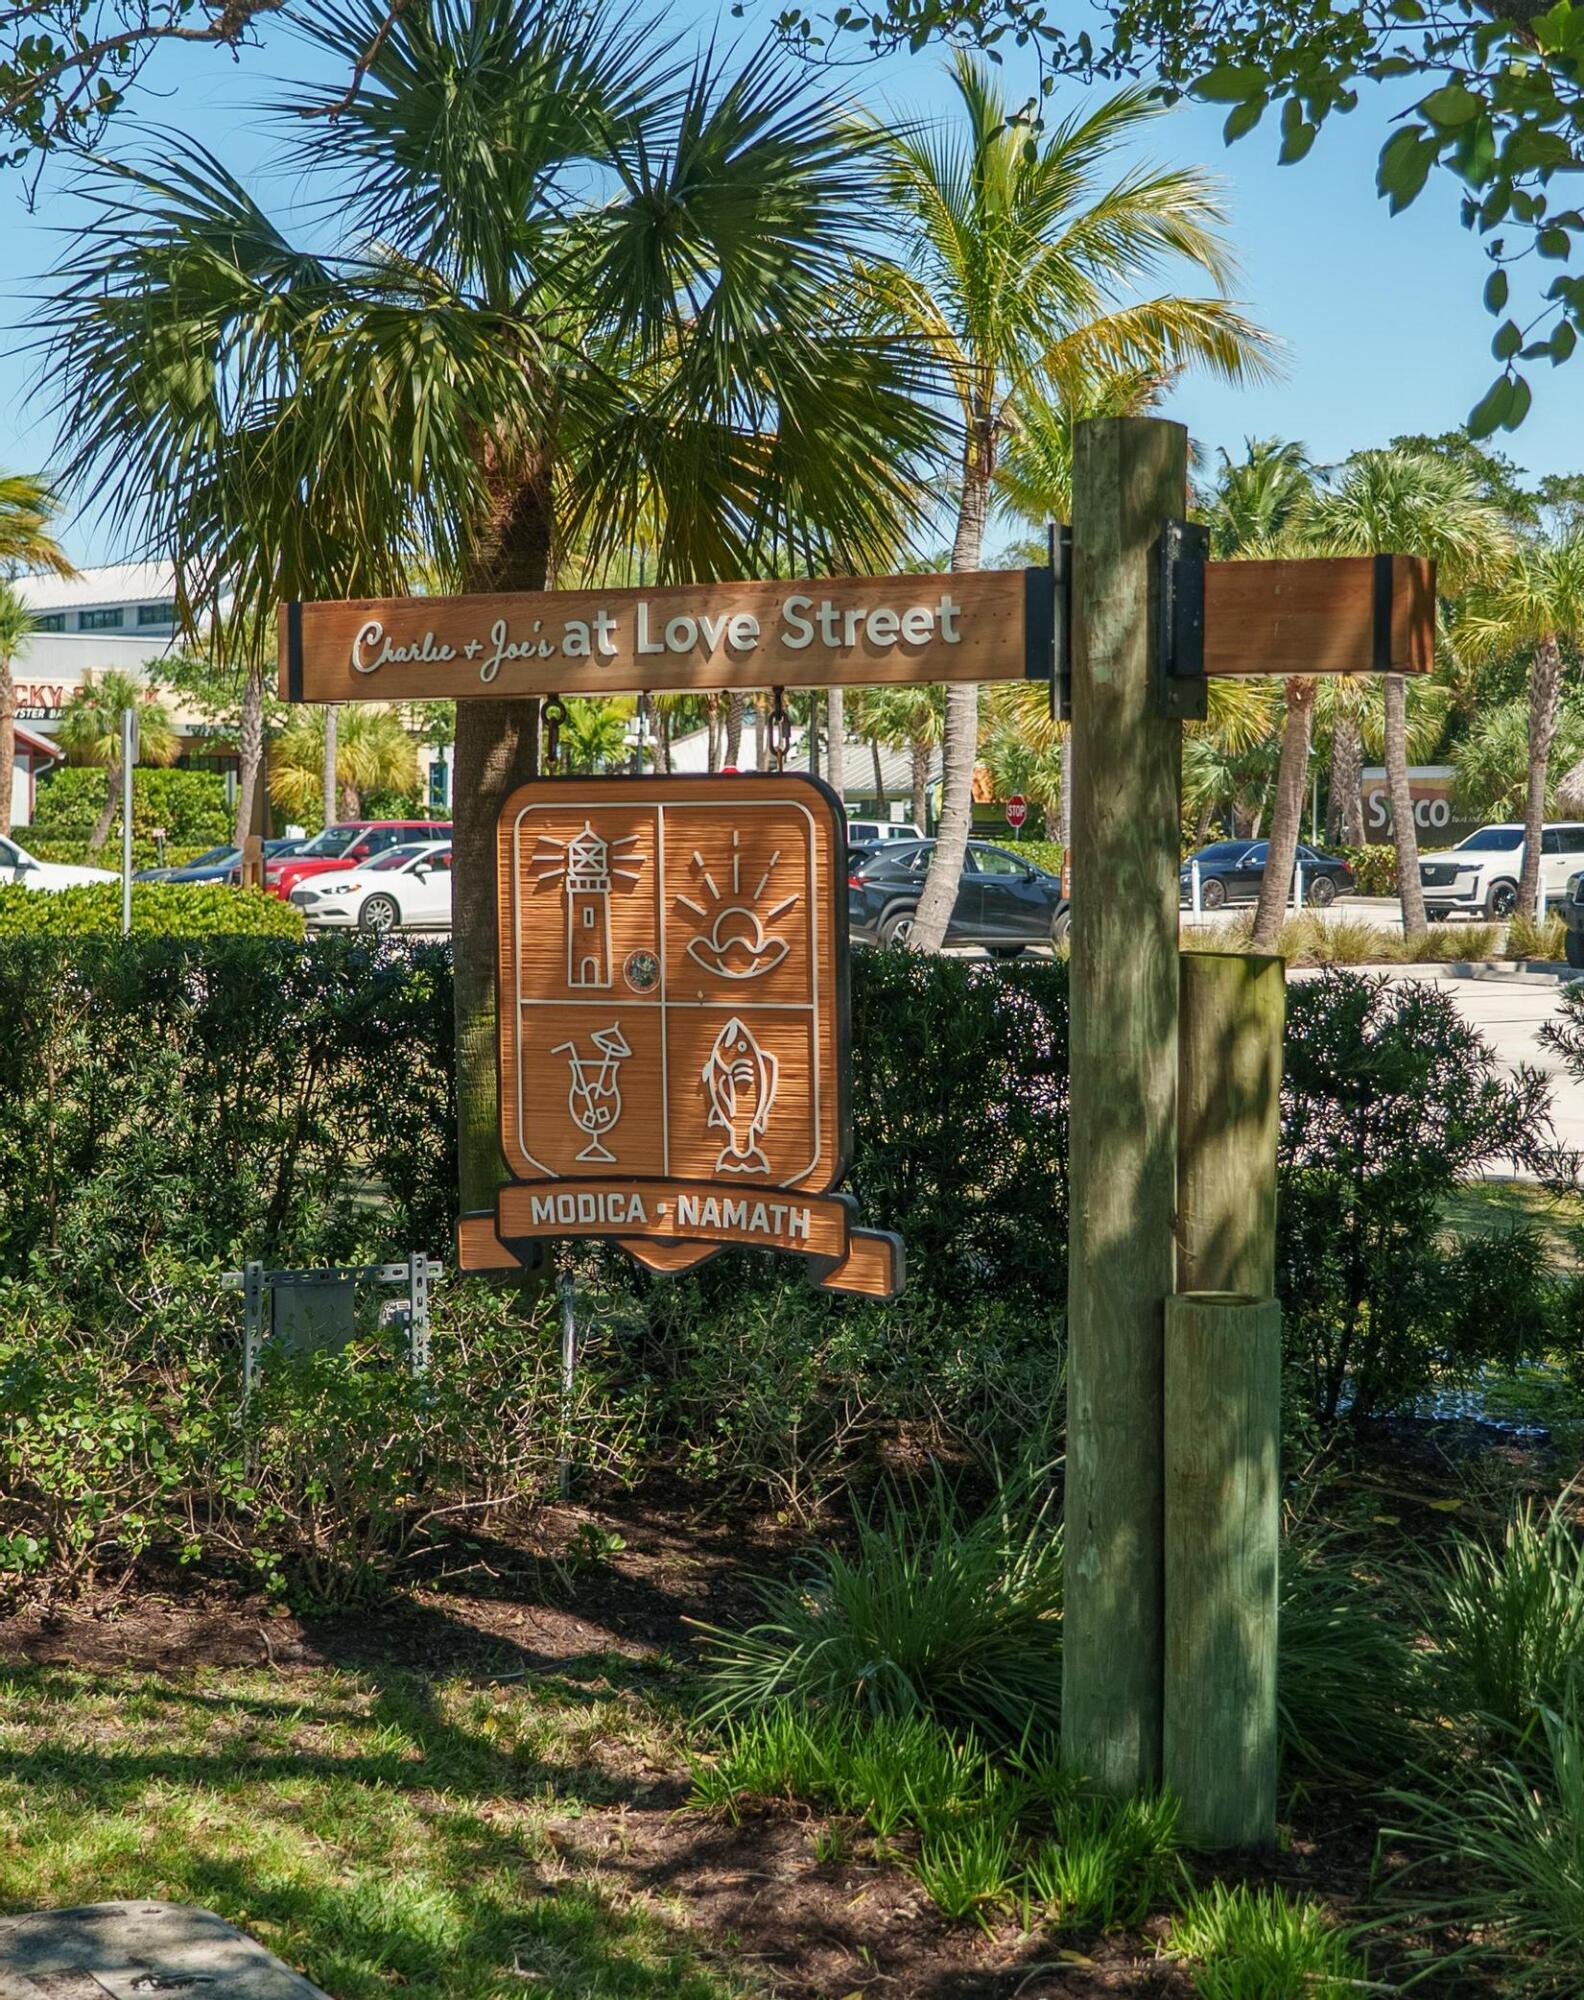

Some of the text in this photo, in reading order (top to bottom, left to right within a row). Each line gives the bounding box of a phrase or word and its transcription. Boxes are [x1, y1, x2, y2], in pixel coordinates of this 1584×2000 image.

[352, 620, 456, 673] Charlie
[480, 619, 555, 682] Joe's
[562, 610, 618, 656] at
[637, 602, 761, 654] Love
[781, 593, 961, 649] Street
[13, 685, 63, 708] CKY
[14, 708, 46, 719] YSTER
[1007, 804, 1025, 817] STOP
[1368, 789, 1450, 836] Sco
[530, 1193, 810, 1239] MODICA NAMATH
